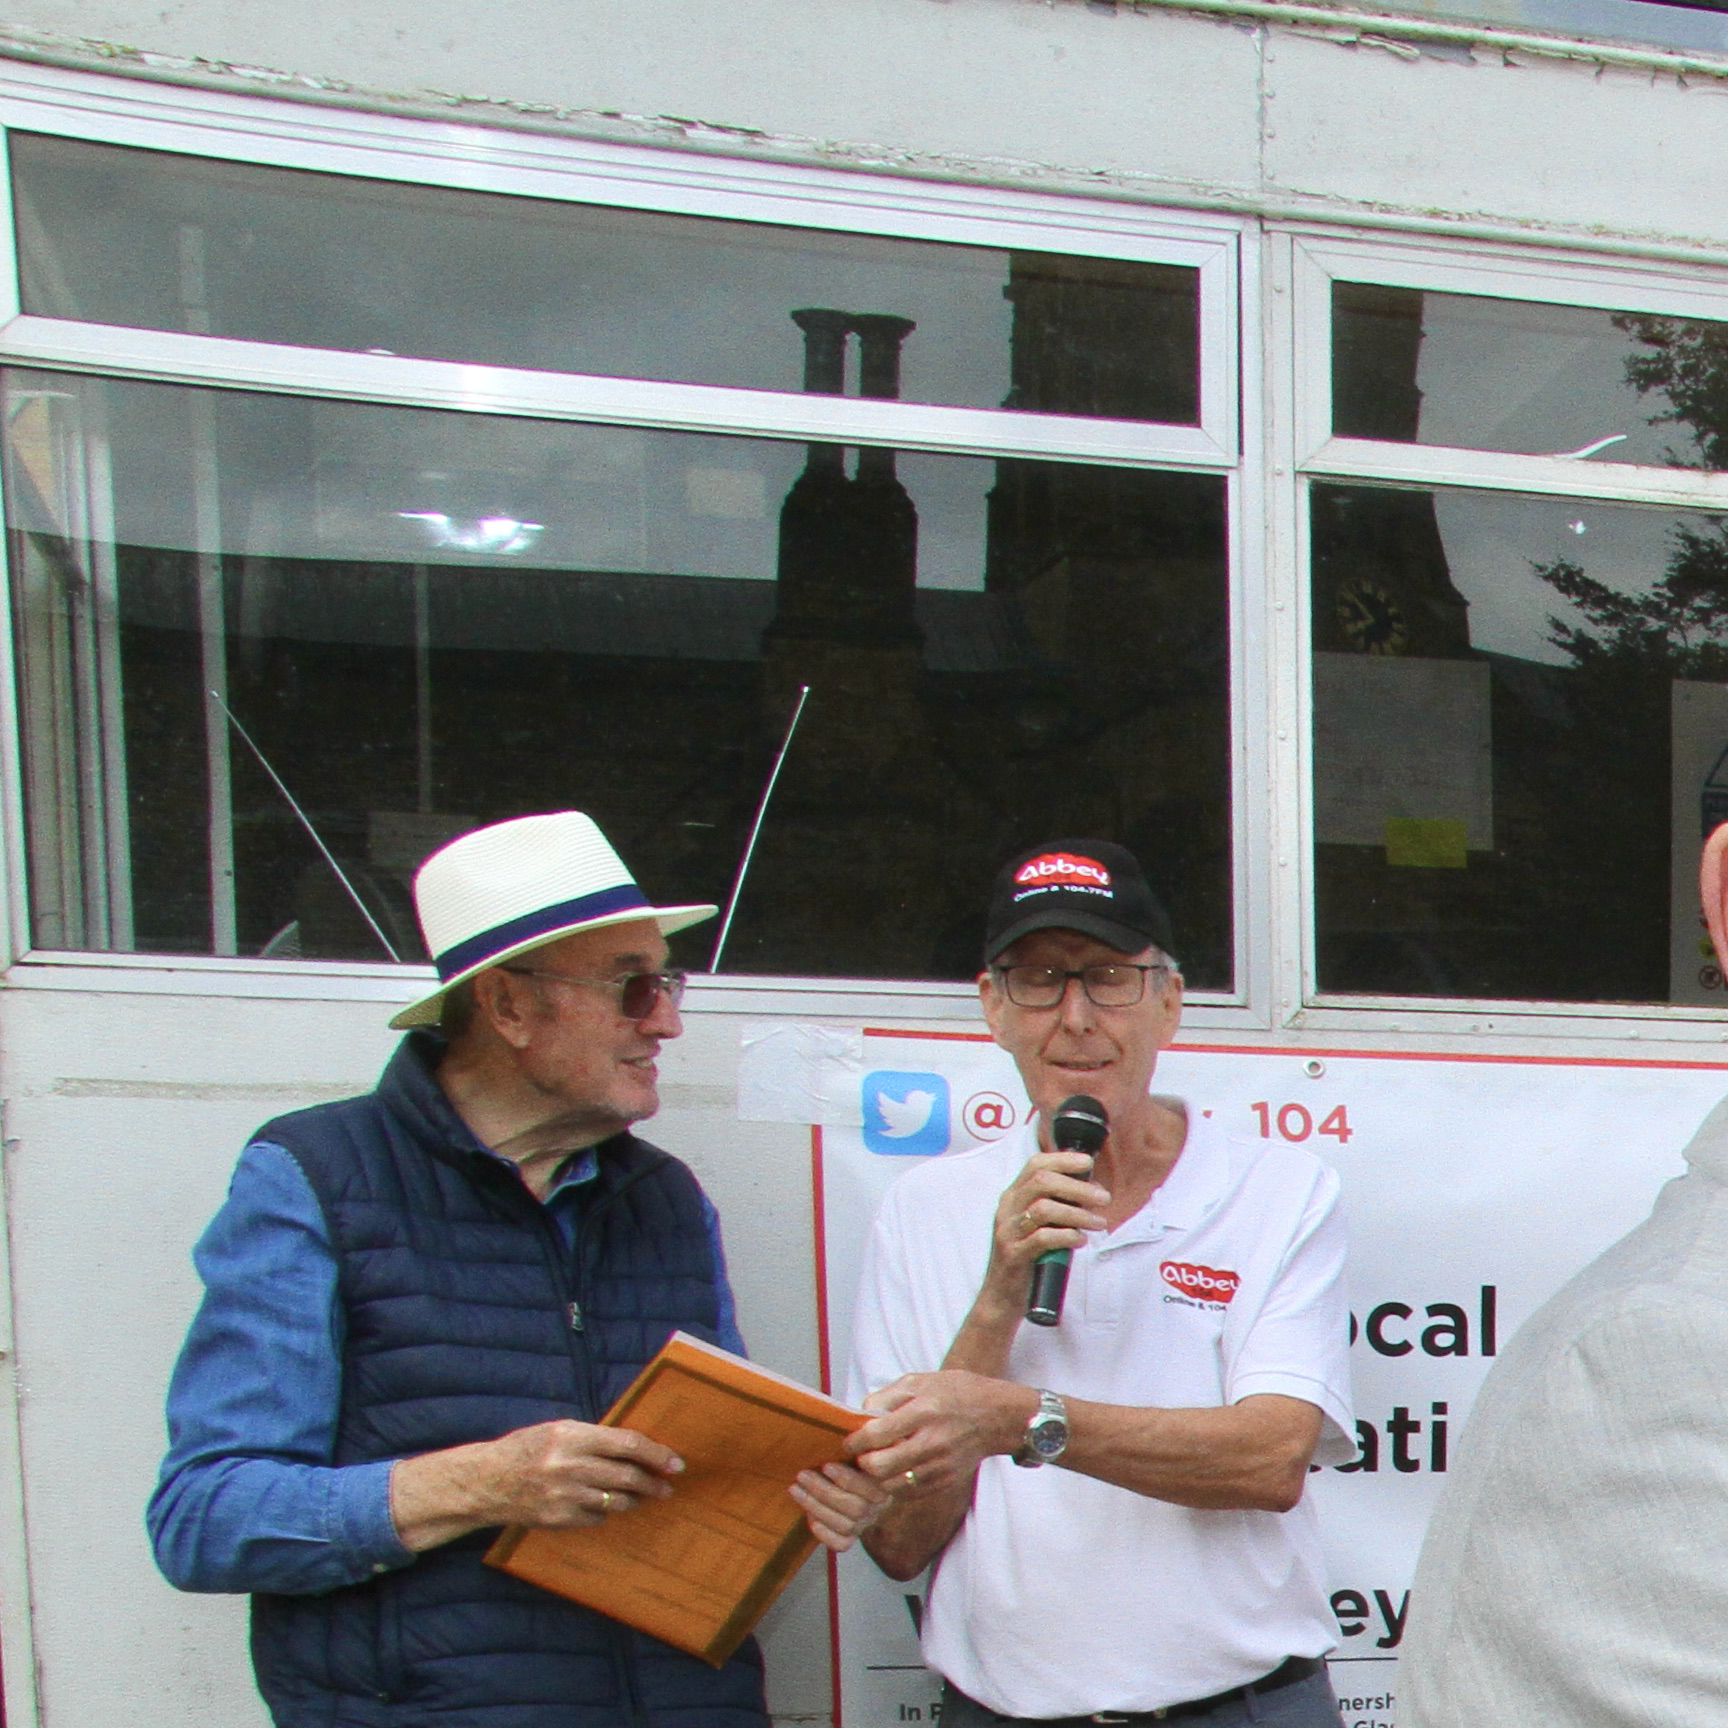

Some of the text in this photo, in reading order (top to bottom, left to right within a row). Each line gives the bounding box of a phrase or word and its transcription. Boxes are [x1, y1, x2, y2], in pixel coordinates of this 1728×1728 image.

[1018, 858, 1109, 886] Abbey
[1251, 1100, 1353, 1144] 104
[1348, 1284, 1497, 1358] cal
[900, 1702, 922, 1721] In
